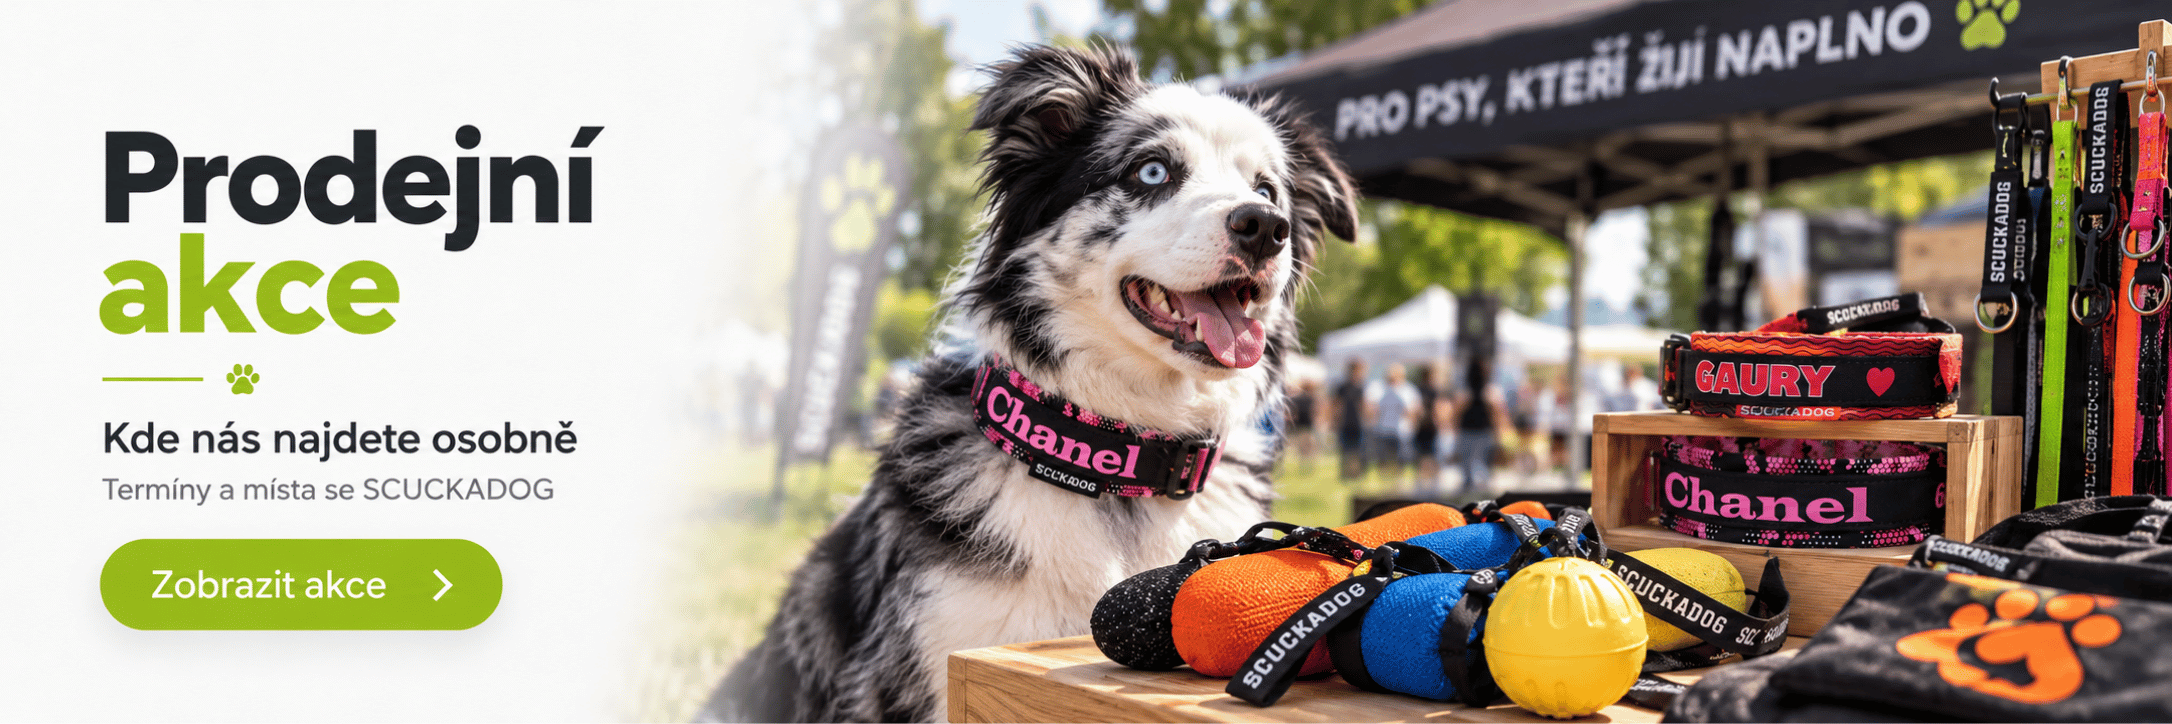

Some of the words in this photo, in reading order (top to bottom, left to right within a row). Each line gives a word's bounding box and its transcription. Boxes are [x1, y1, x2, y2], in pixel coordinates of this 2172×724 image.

[1335, 90, 1410, 140] PRO
[1414, 76, 1496, 127] PSY,
[1714, 1, 1931, 80] NAPLNO
[2089, 87, 2109, 194] SCUCKADOG
[1990, 181, 2011, 283] SCUCKADOG
[1695, 360, 1836, 398] GAURY
[986, 385, 1141, 479] Chanel
[1664, 471, 1874, 525] Chanel
[1242, 582, 1367, 689] SCUCKADOG
[1617, 564, 1728, 634] SCUCKADOG
